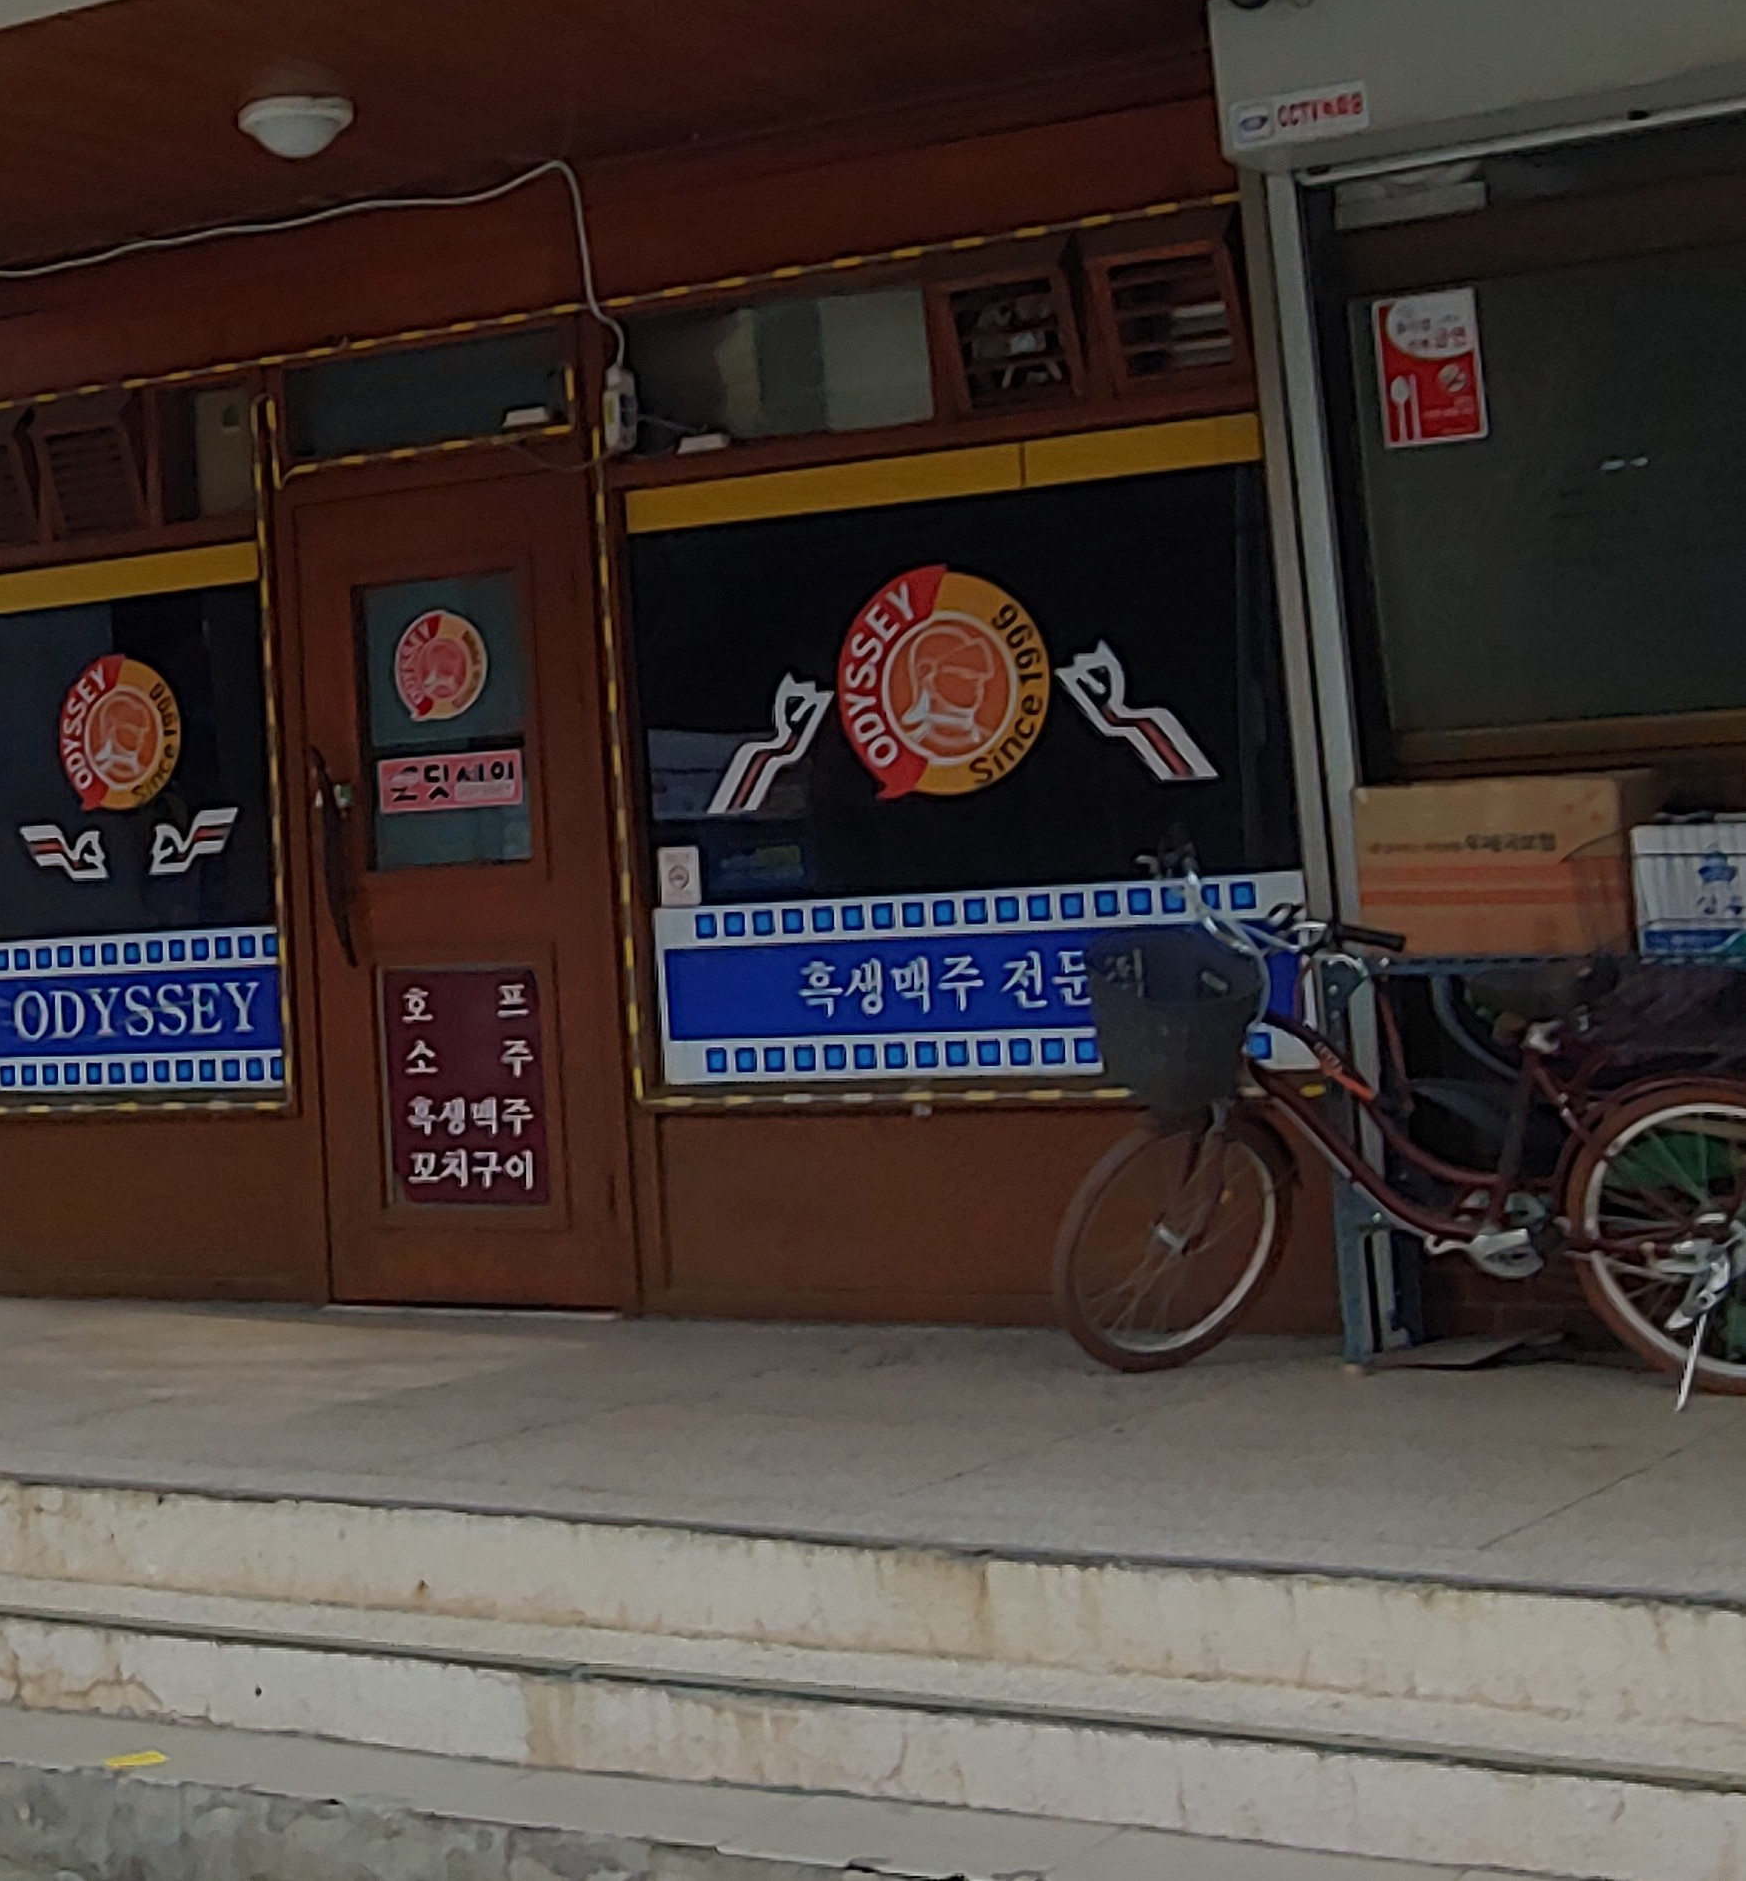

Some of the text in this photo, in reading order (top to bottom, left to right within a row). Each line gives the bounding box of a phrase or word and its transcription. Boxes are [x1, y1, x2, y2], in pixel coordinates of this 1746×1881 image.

[845, 582, 915, 768] ODYSSEY
[969, 604, 1043, 783] Since 1996
[62, 664, 106, 789] ODYSSEY
[14, 981, 259, 1041] ODYSSEY
[798, 956, 984, 1018] 흑생맥주
[407, 1095, 535, 1136] 흑생맥주
[408, 1148, 535, 1190] 꼬치구이
